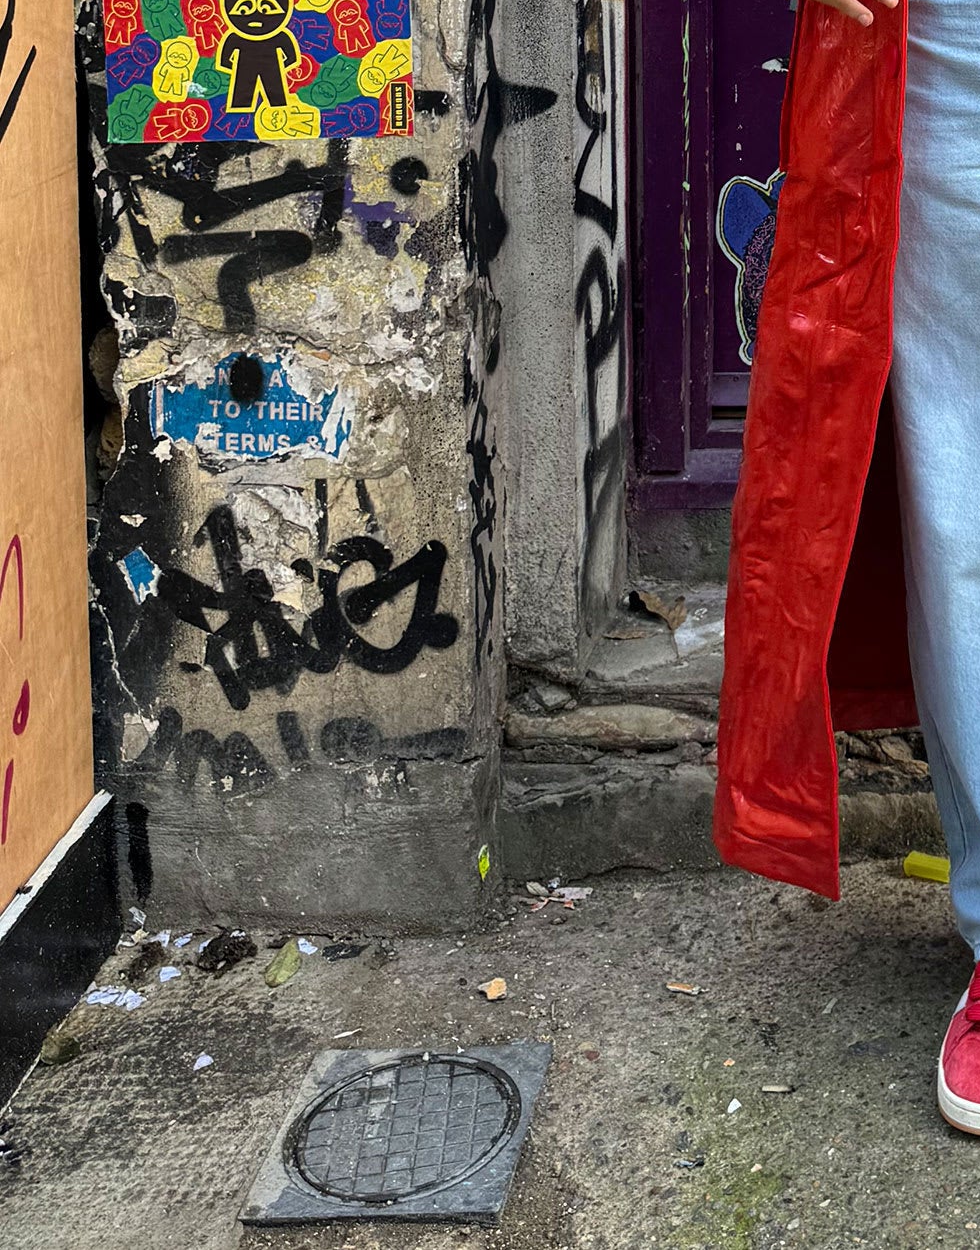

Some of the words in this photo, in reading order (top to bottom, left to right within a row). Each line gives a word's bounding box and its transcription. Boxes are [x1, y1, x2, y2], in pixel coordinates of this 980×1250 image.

[209, 399, 241, 418] TO
[256, 401, 324, 422] THEIR
[213, 433, 291, 453] TERMS
